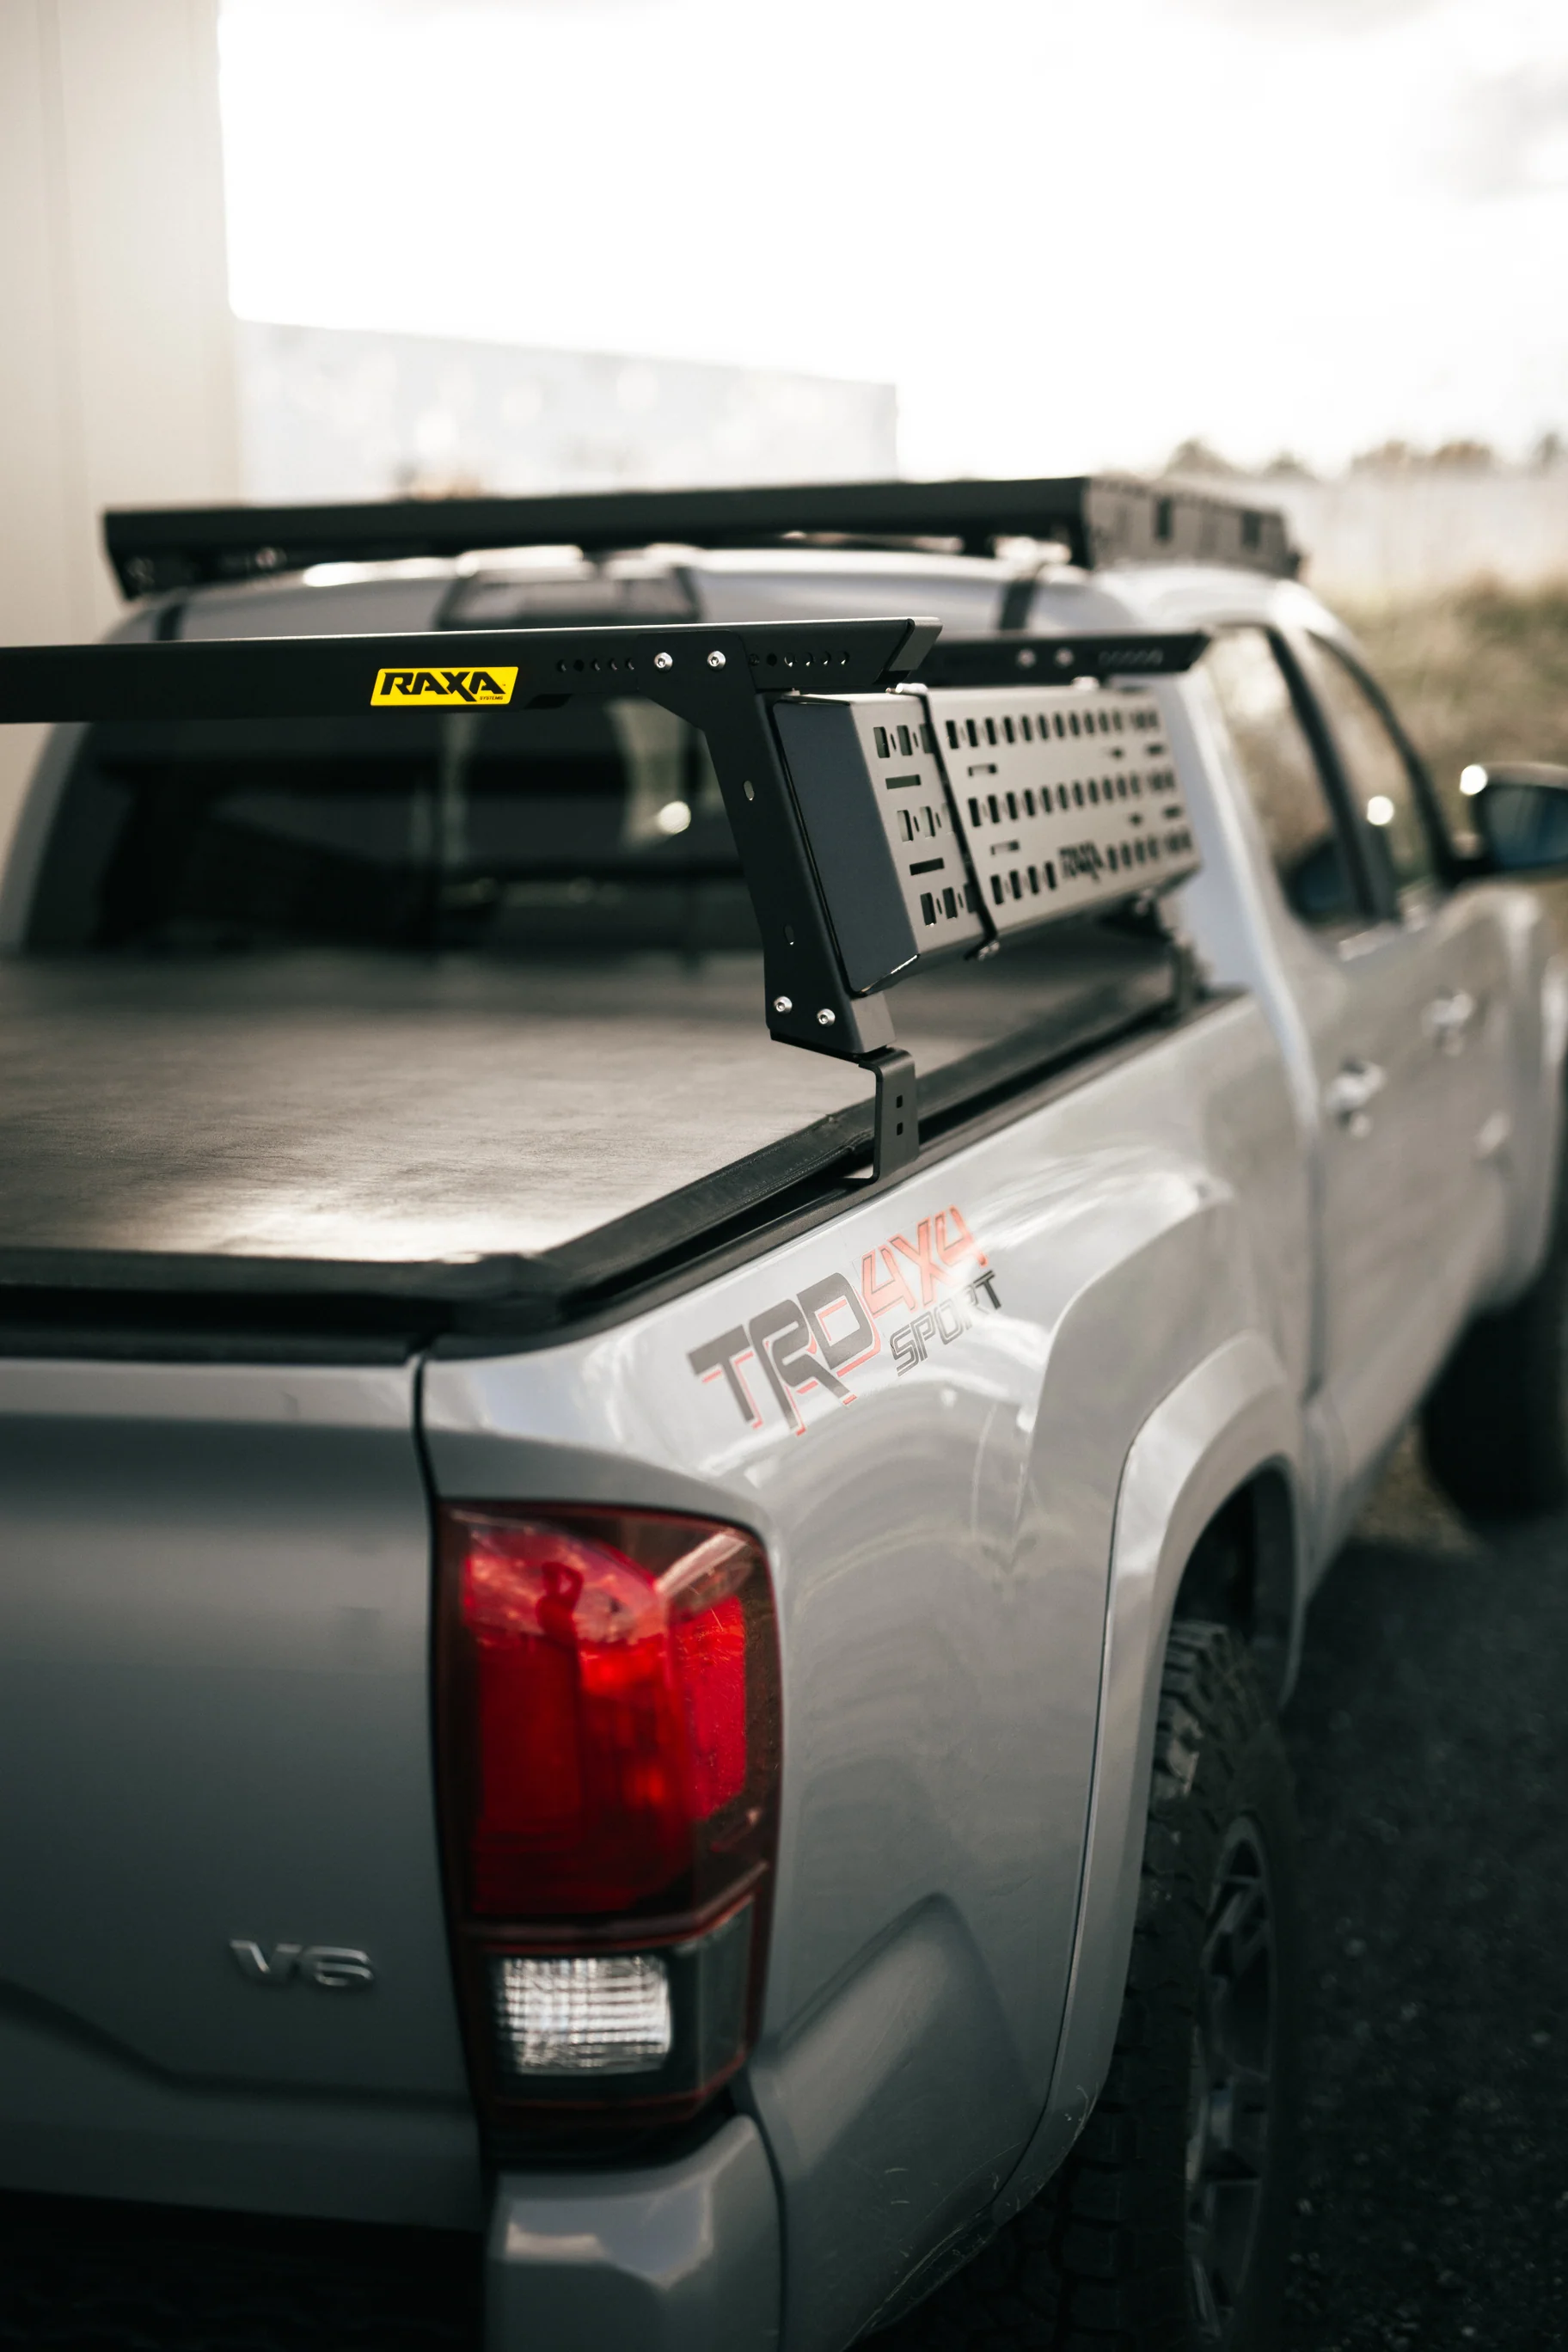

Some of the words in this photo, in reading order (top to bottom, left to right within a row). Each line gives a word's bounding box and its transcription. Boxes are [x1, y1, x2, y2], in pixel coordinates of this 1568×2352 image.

[380, 671, 506, 702] RAXA
[688, 1272, 881, 1436] TRD
[229, 1939, 376, 1987] V6
